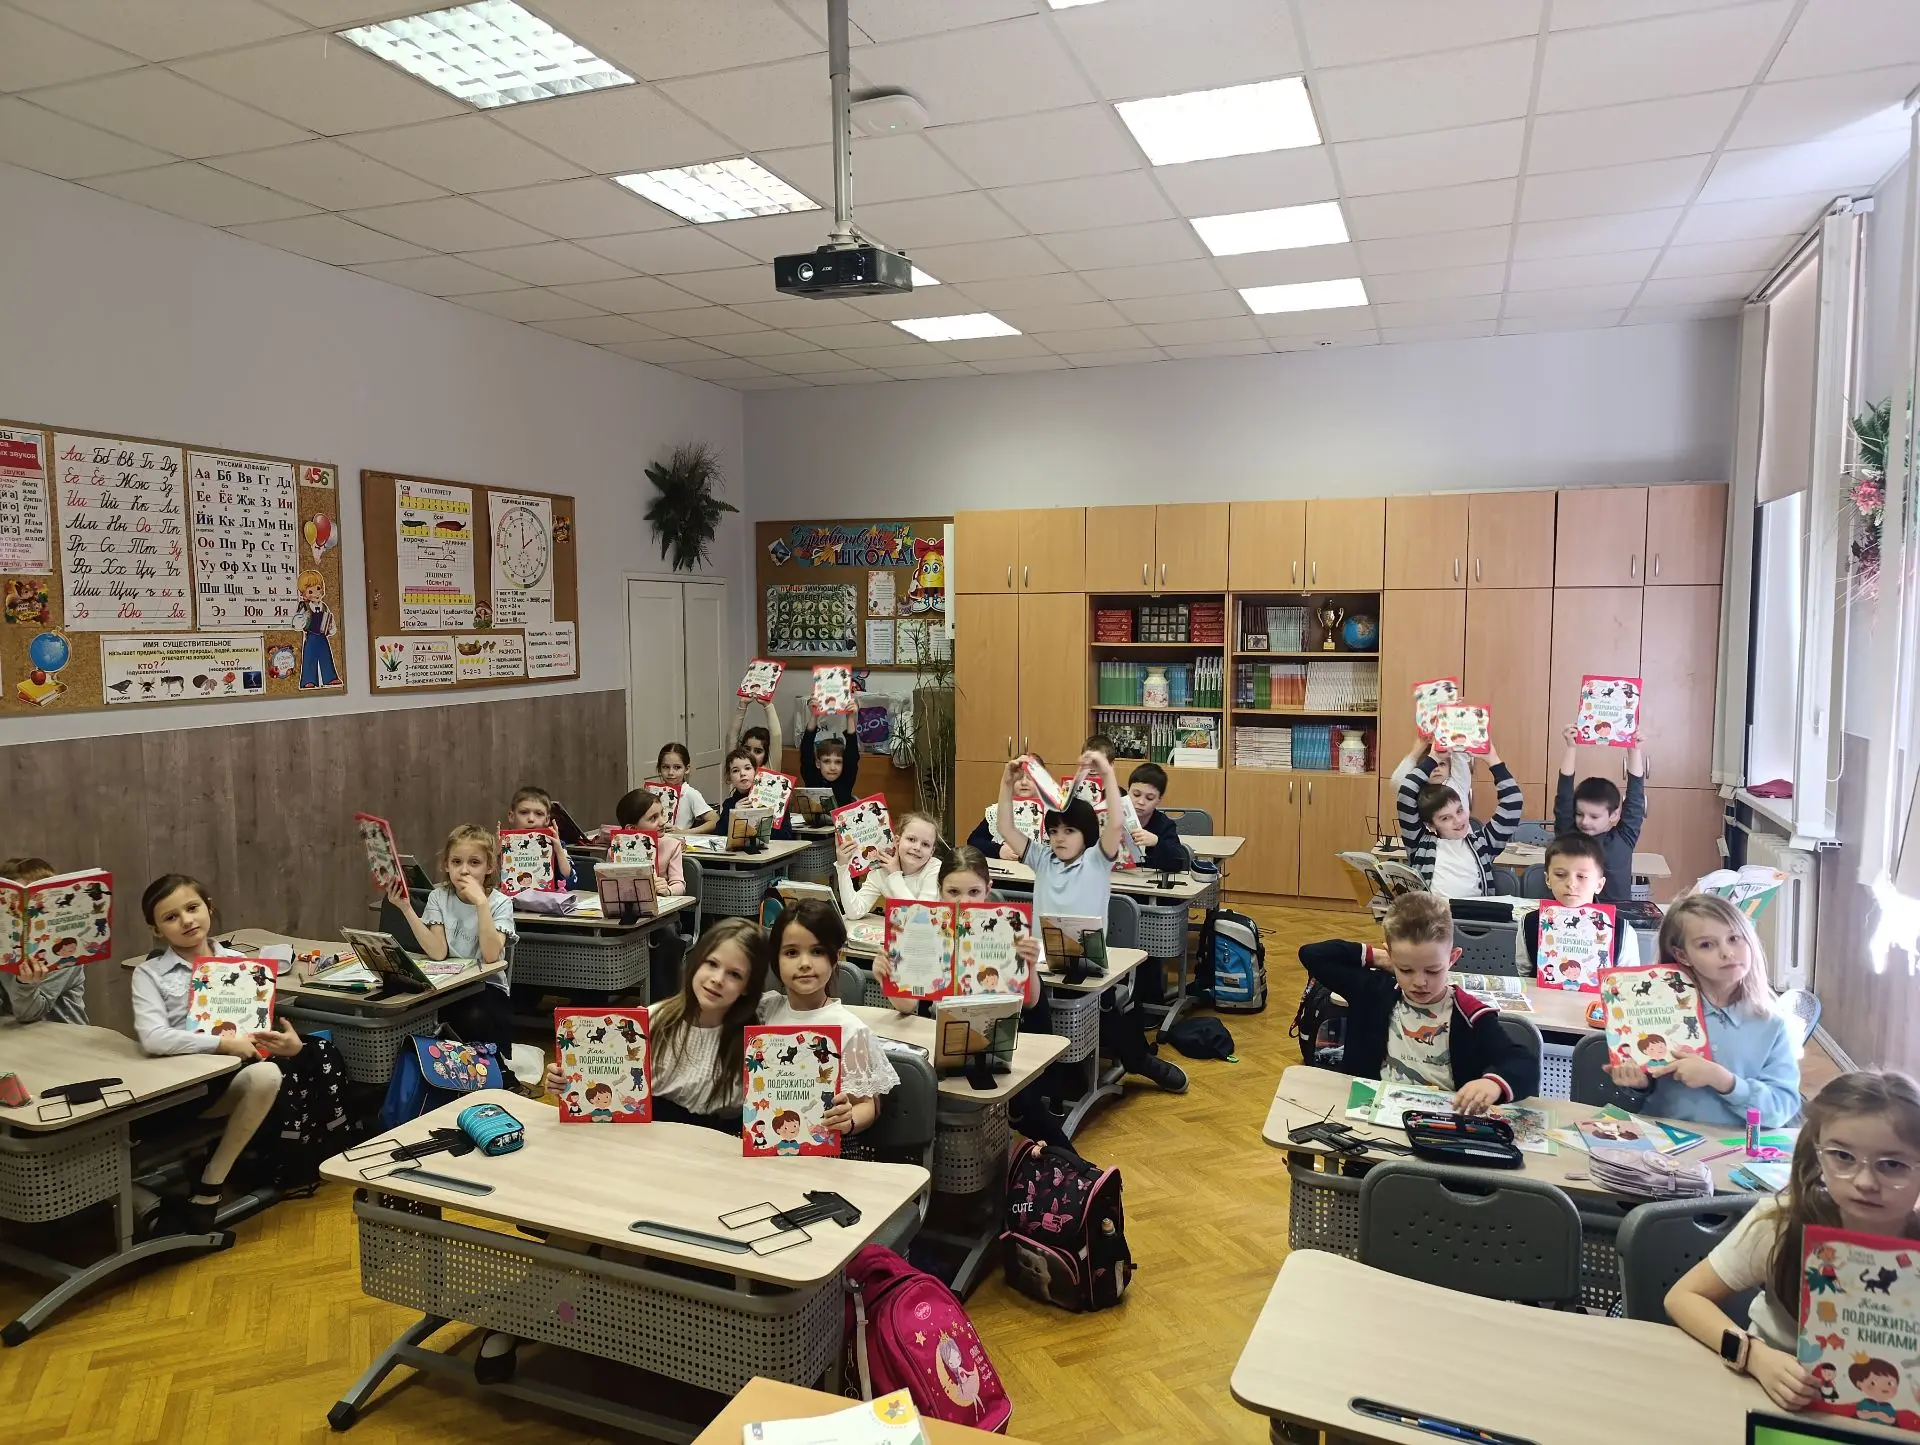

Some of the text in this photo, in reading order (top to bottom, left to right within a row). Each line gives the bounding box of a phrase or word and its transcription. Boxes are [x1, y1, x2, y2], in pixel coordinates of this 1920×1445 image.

[61, 445, 178, 477] Аа Бб Вв Гг Дд
[217, 460, 270, 472] РУССКИЙ АЛФАВИТ
[65, 467, 173, 497] Ее Ёё Жж Зз
[195, 468, 291, 489] Аа Бб Вв Гг Дд
[305, 467, 329, 486] 456
[67, 490, 180, 513] Ии Йй Кк Лл
[196, 490, 292, 509] Ее Ёё Жж Зз Ии
[66, 513, 180, 534] Мм Нн Оо Пп
[196, 511, 293, 531] Йй Кк Лл Мм Нн
[67, 535, 182, 561] Рр Сс Тт Уу
[198, 537, 294, 552] Оо Пп Рр Сс Тт
[834, 548, 915, 566] ШКОЛА!
[70, 558, 180, 579] Фф Хх Цц Чч
[200, 560, 295, 574] Уу Фф Хх Цц Чч
[73, 580, 101, 596] Шш
[110, 581, 139, 600] Щщ
[200, 583, 219, 593] Шш
[224, 584, 243, 595] Щщ
[73, 603, 185, 618] Ээ Юю Яя
[212, 606, 288, 616] Ээ Юю Яя
[163, 640, 231, 648] СУЩЕСТВИТЕЛЬНОЕ
[1637, 1017, 1672, 1025] КНИГАМИ
[580, 1056, 624, 1064] ПОДРУЖИТЬСЯ
[588, 1066, 620, 1075] КНИГАМИ
[767, 1079, 815, 1088] ПОДРУЖИТЬСЯ
[777, 1091, 810, 1100] КНИГАМИ
[1012, 1202, 1034, 1213] CUTE
[1842, 1308, 1920, 1334] ПОДРУЖИТЬС
[1858, 1328, 1917, 1352] КНИГАМИ
